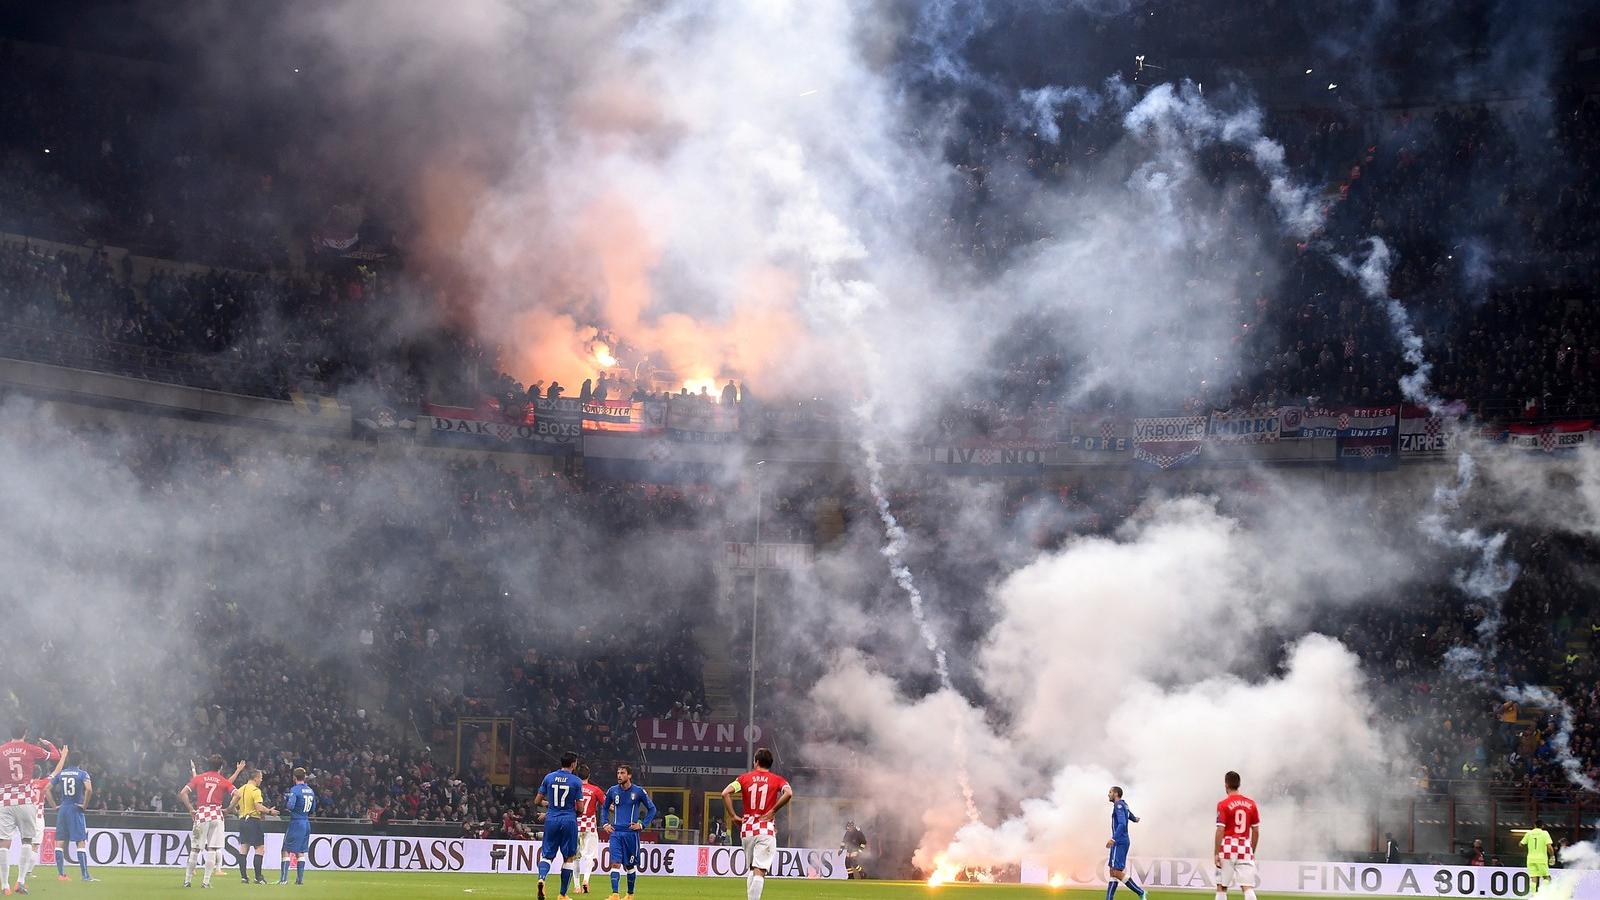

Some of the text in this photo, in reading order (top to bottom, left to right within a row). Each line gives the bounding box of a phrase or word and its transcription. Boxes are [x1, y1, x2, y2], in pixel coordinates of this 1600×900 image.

[1354, 408, 1391, 418] BRIJEG
[538, 422, 580, 436] BOYS
[1136, 423, 1203, 437] VRBOVEC
[1351, 428, 1388, 437] UNITED
[652, 718, 762, 743] LIVNO
[9, 756, 24, 781] 5
[62, 777, 76, 796] 13
[205, 782, 217, 803] 7
[552, 784, 570, 807] 17
[303, 795, 314, 813] 16
[615, 795, 620, 804] 8
[748, 783, 768, 810] 11
[1234, 809, 1247, 834] 9
[1533, 837, 1538, 850] 1
[308, 837, 465, 871] COMPASS
[630, 855, 635, 864] 8
[1299, 866, 1382, 891] FINO
[1397, 868, 1421, 893] A
